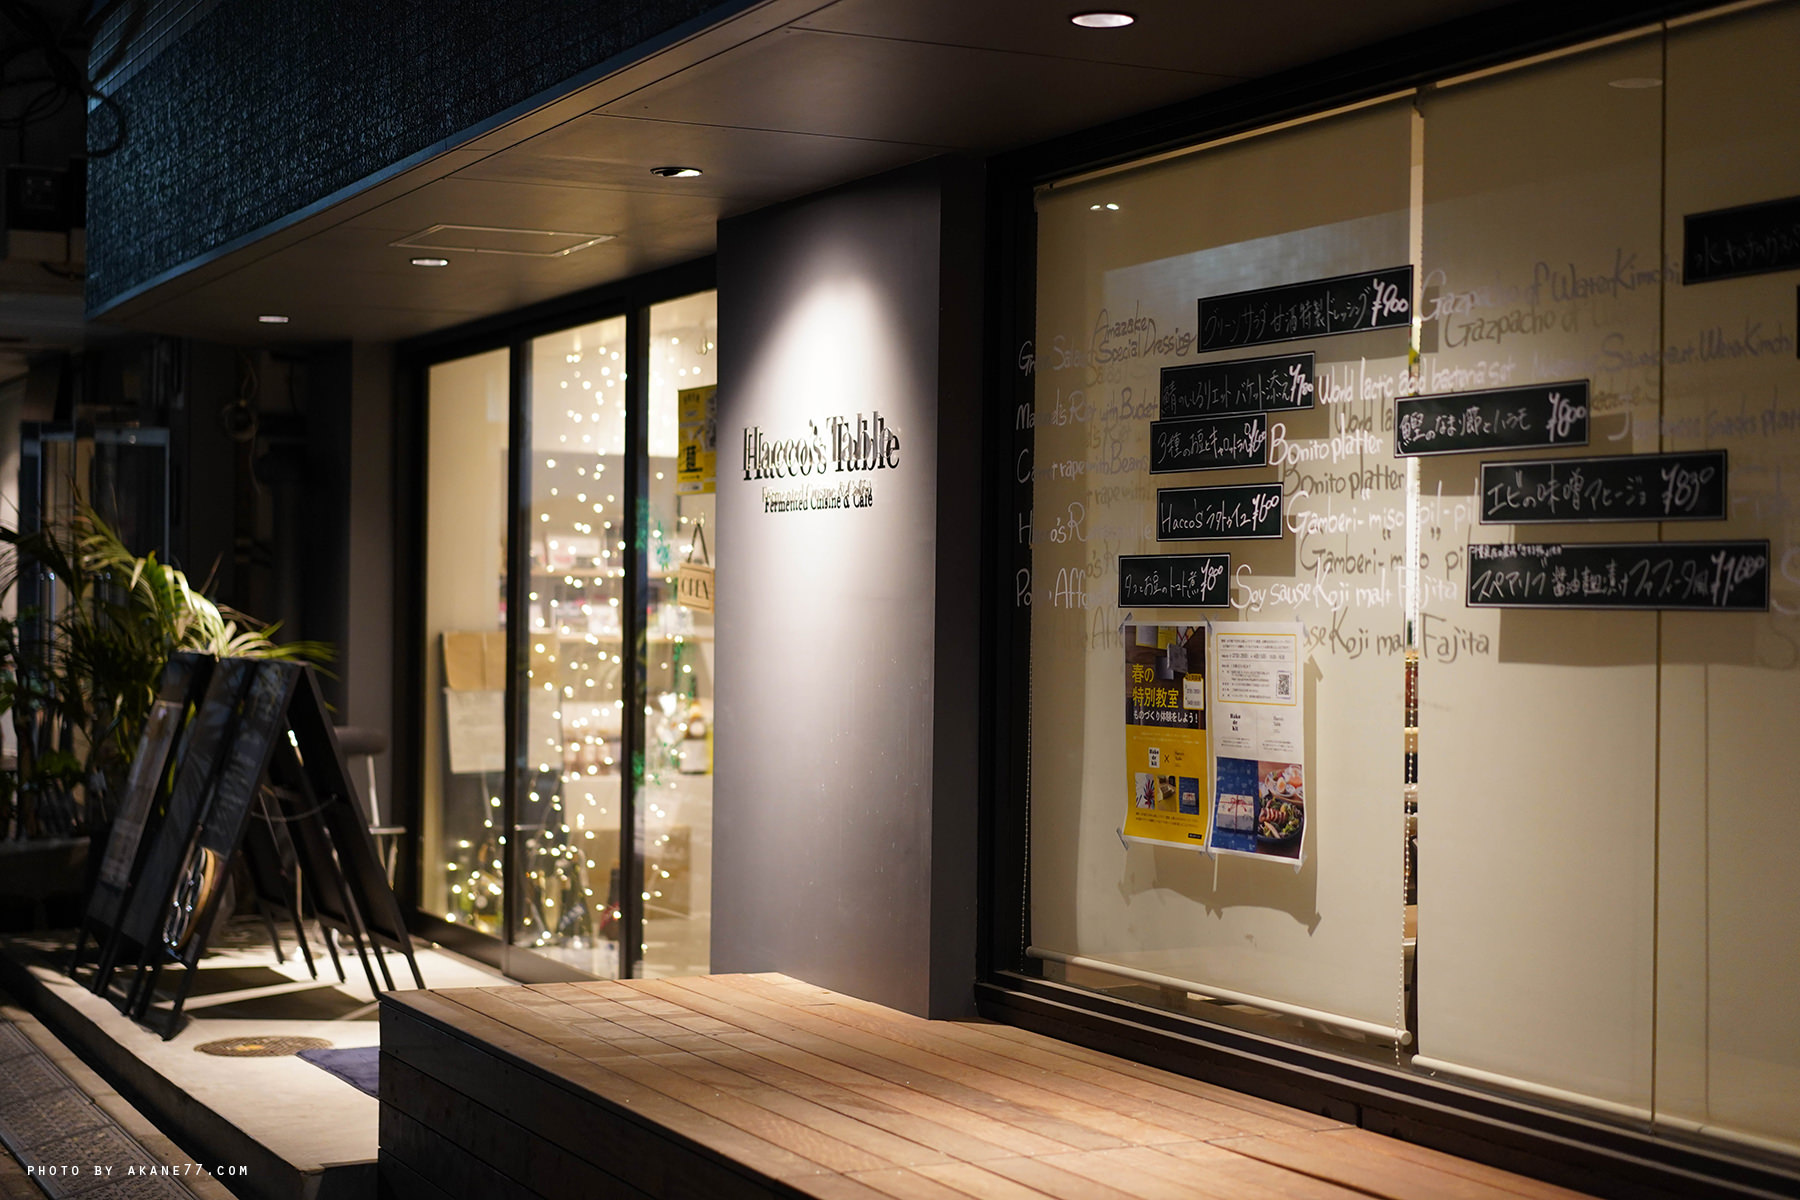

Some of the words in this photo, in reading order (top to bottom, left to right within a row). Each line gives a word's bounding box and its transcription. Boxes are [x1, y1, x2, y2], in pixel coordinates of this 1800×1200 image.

[1371, 278, 1409, 327] ¥900
[1268, 423, 1330, 465] Bonito
[1331, 412, 1385, 464] platter
[1546, 391, 1587, 443] ¥800
[742, 418, 827, 480] Hacco's
[827, 411, 901, 472] Table
[762, 485, 808, 514] Fermented
[806, 482, 841, 511] Cuisine
[1251, 493, 1280, 532] ¥600
[1201, 558, 1224, 603] ¥800
[1230, 564, 1266, 612] Soy
[1131, 663, 1154, 684] 春の
[1132, 686, 1179, 709] 特別教室
